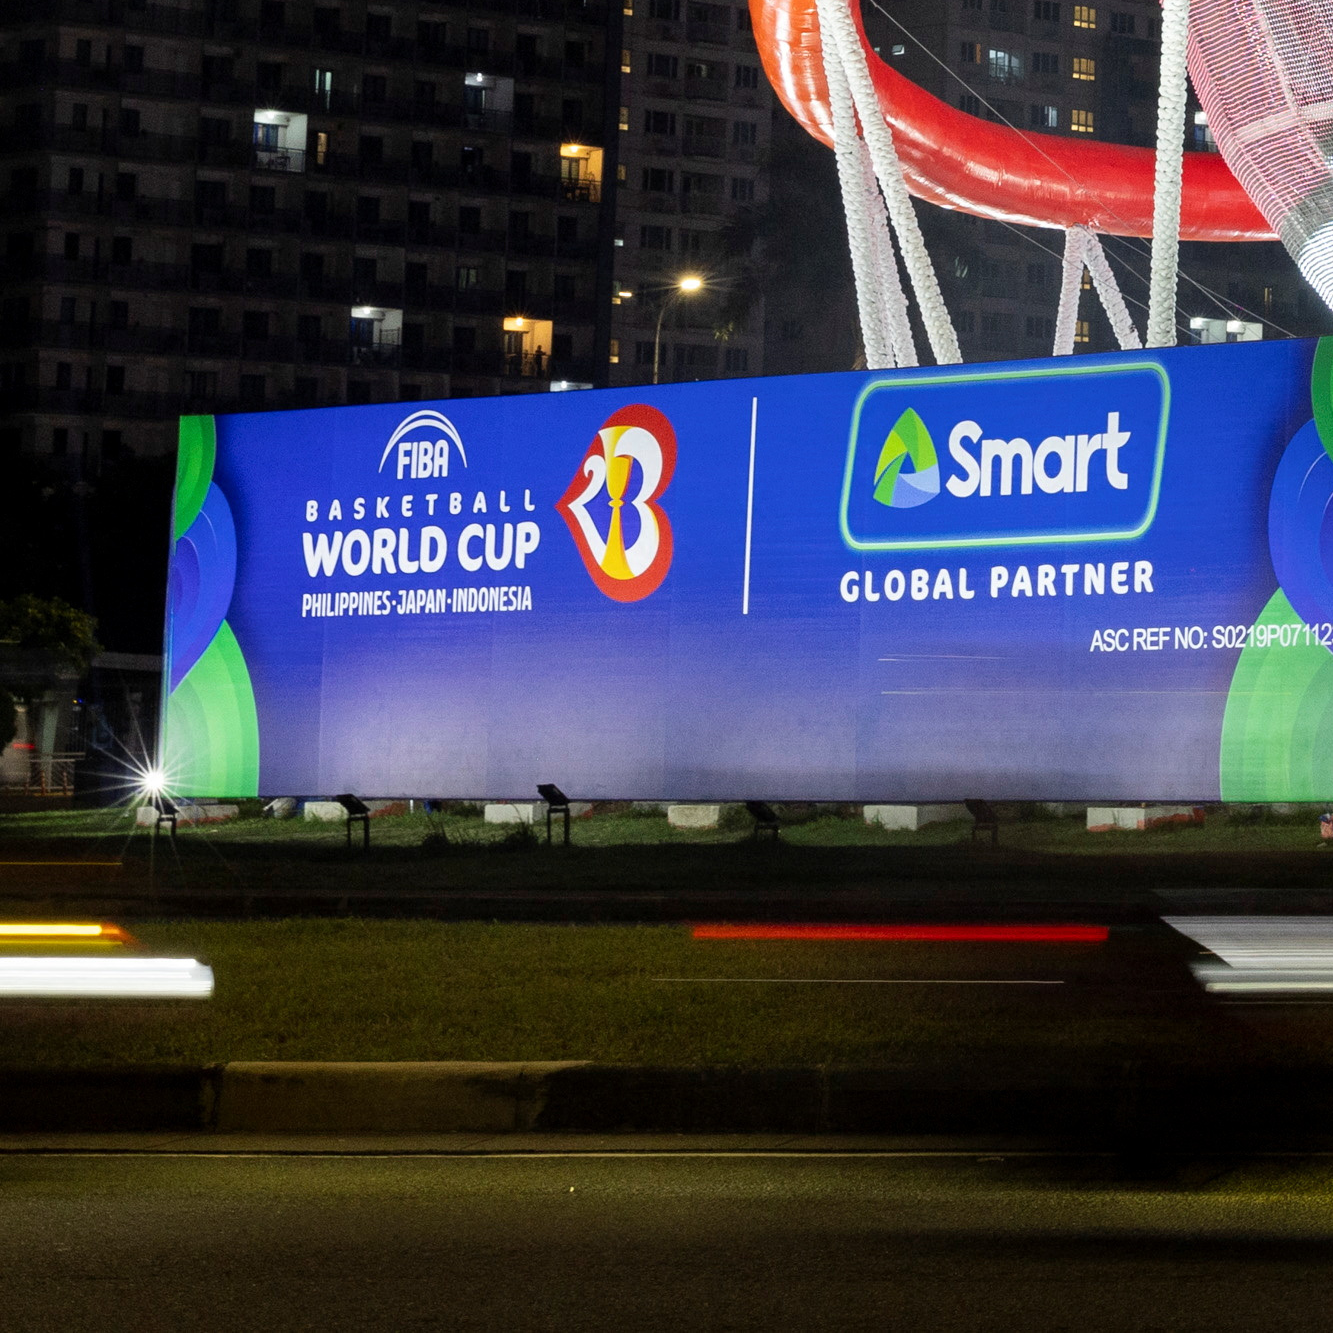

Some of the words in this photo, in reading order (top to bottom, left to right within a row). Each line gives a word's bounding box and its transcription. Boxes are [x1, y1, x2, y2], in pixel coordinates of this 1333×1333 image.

[396, 440, 449, 480] FIBA
[945, 411, 1132, 498] Smart
[305, 488, 536, 523] BASKETBALL
[302, 524, 448, 578] WORLD
[457, 521, 541, 572] CUP
[839, 567, 976, 603] GLOBAL
[990, 560, 1154, 599] PARTNER
[1089, 628, 1130, 653] ASC
[1132, 627, 1171, 651] REF
[1174, 626, 1208, 650] NO:
